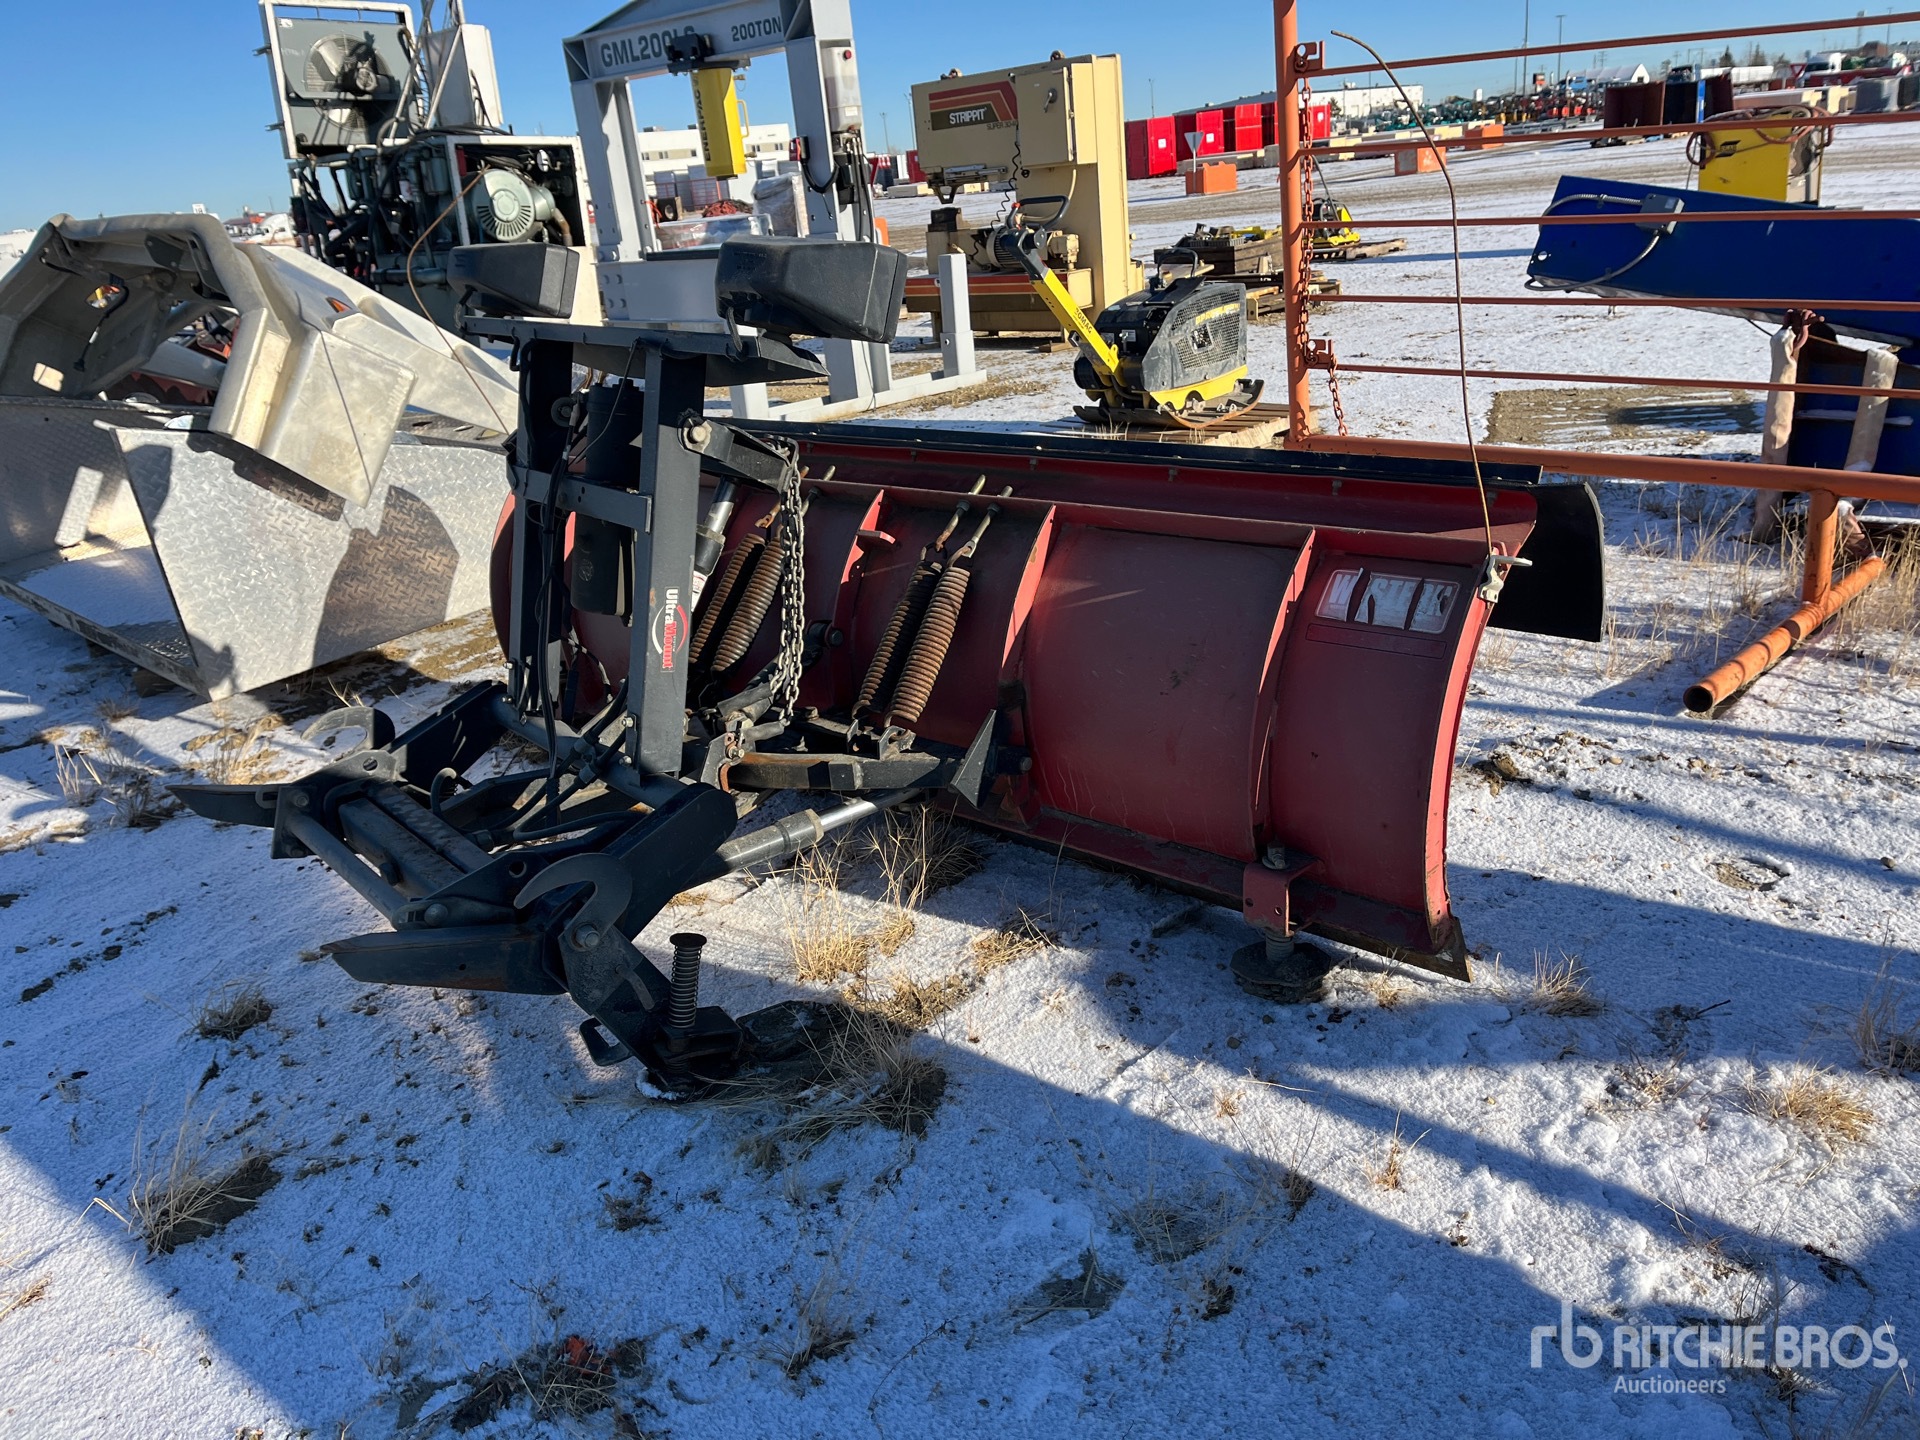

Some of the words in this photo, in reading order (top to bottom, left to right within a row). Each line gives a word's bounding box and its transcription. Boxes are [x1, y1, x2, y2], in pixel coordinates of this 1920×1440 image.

[731, 16, 782, 42] 200TON
[949, 108, 986, 125] STRIPPIT
[662, 588, 679, 669] UltraMount
